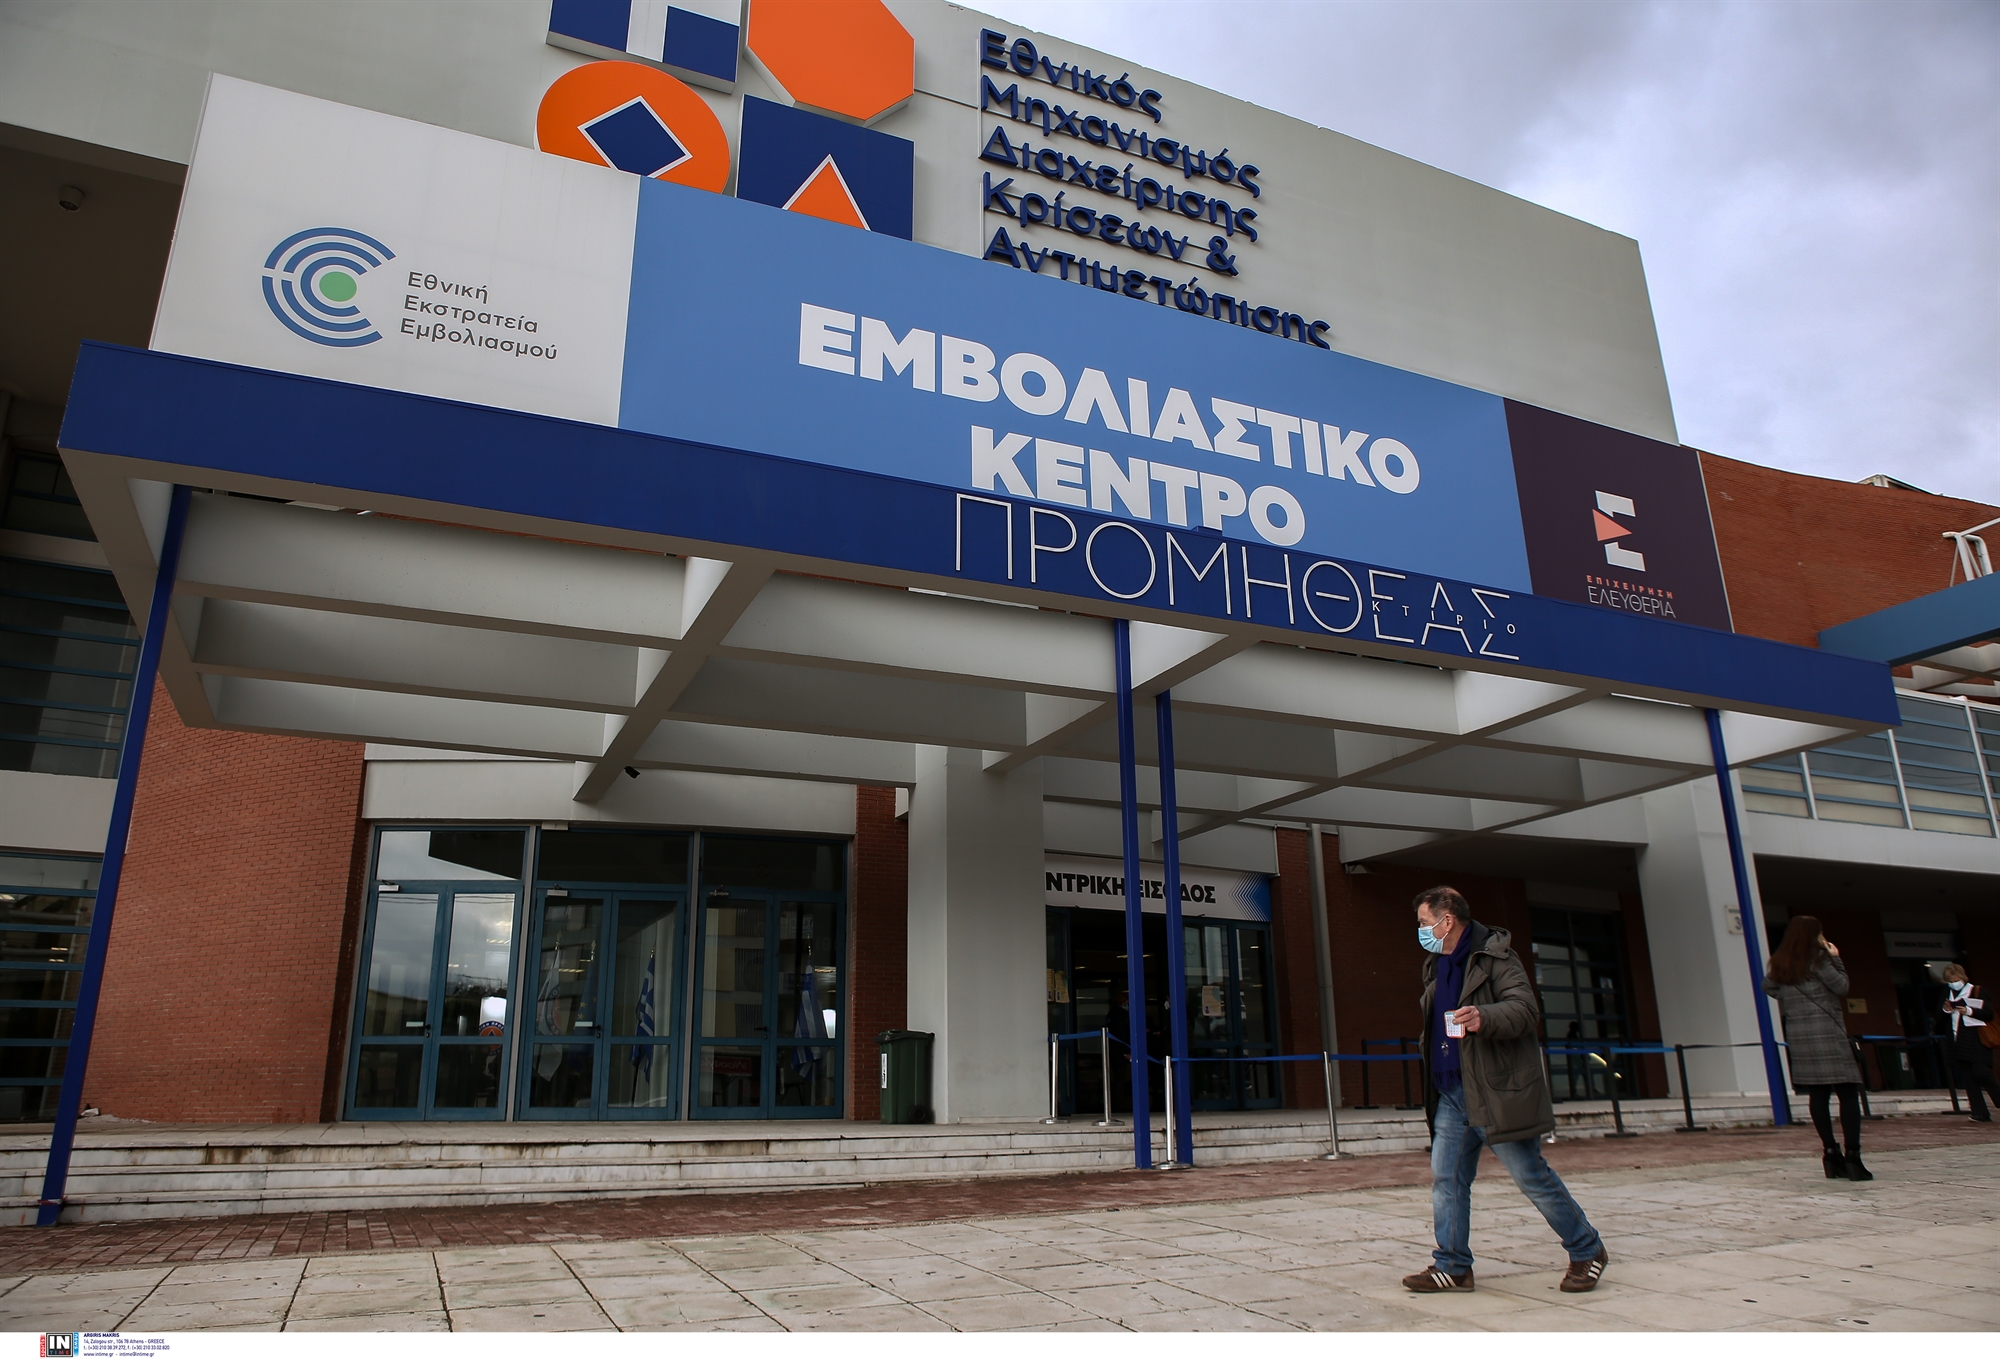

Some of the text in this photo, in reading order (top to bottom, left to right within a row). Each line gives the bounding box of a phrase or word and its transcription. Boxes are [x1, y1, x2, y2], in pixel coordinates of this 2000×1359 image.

[981, 27, 1163, 124] Εθνικός
[979, 125, 1258, 243] Διαχείρισης
[981, 74, 1261, 199] Μηχανισμός
[983, 171, 1239, 277] Κρίσεων &
[403, 294, 539, 334] Εκστρατεία
[407, 271, 489, 304] Εθνική
[983, 226, 1331, 350] Αντιμετώπισης
[400, 317, 559, 361] Εμβολιασμού
[798, 302, 1421, 495] ΕΜΒΟΛΙΑΣΤΙΚΟ
[970, 424, 1306, 547] ΚΕΝΤΡΟ
[955, 492, 1519, 661] ΠΡΟΜΗΘΕΑΣ
[1586, 574, 1675, 600] ΕΠΙΧΕΙΡΗΣΗ
[1587, 585, 1677, 619] ΕΛΕΥΘΕΡΙΑ
[1139, 879, 1217, 904] ΙΣΔΟΣ
